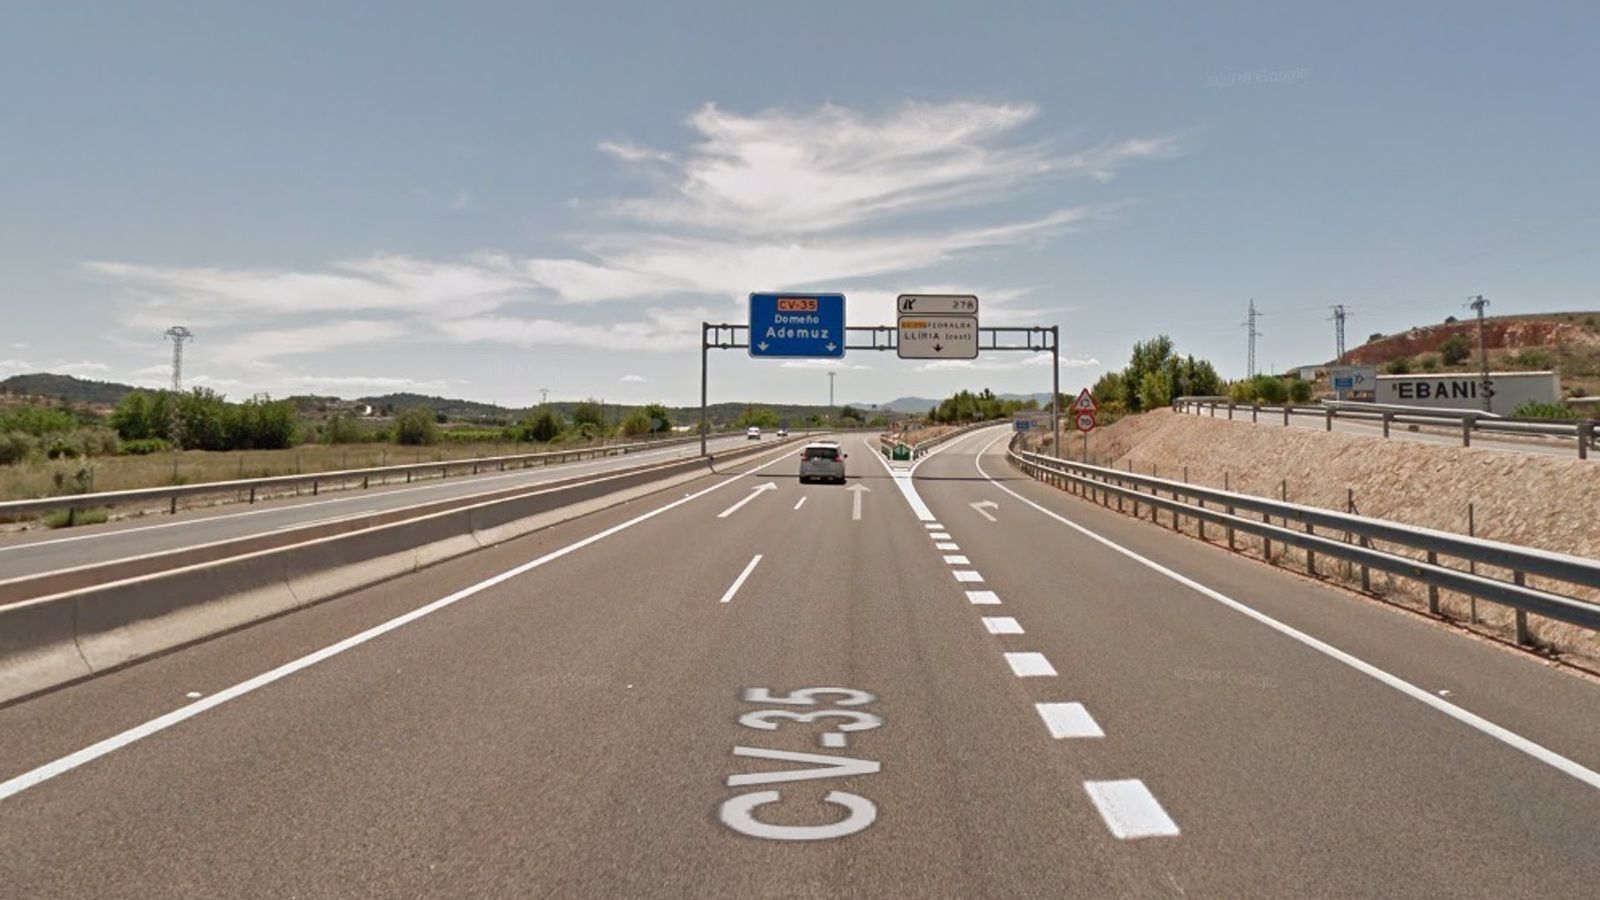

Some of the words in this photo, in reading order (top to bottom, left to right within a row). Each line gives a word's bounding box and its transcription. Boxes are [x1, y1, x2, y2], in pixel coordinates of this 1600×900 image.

[779, 300, 816, 310] CV-35
[775, 314, 820, 324] Domeño
[766, 326, 829, 339] Ademuz
[720, 686, 884, 840] CV-35
